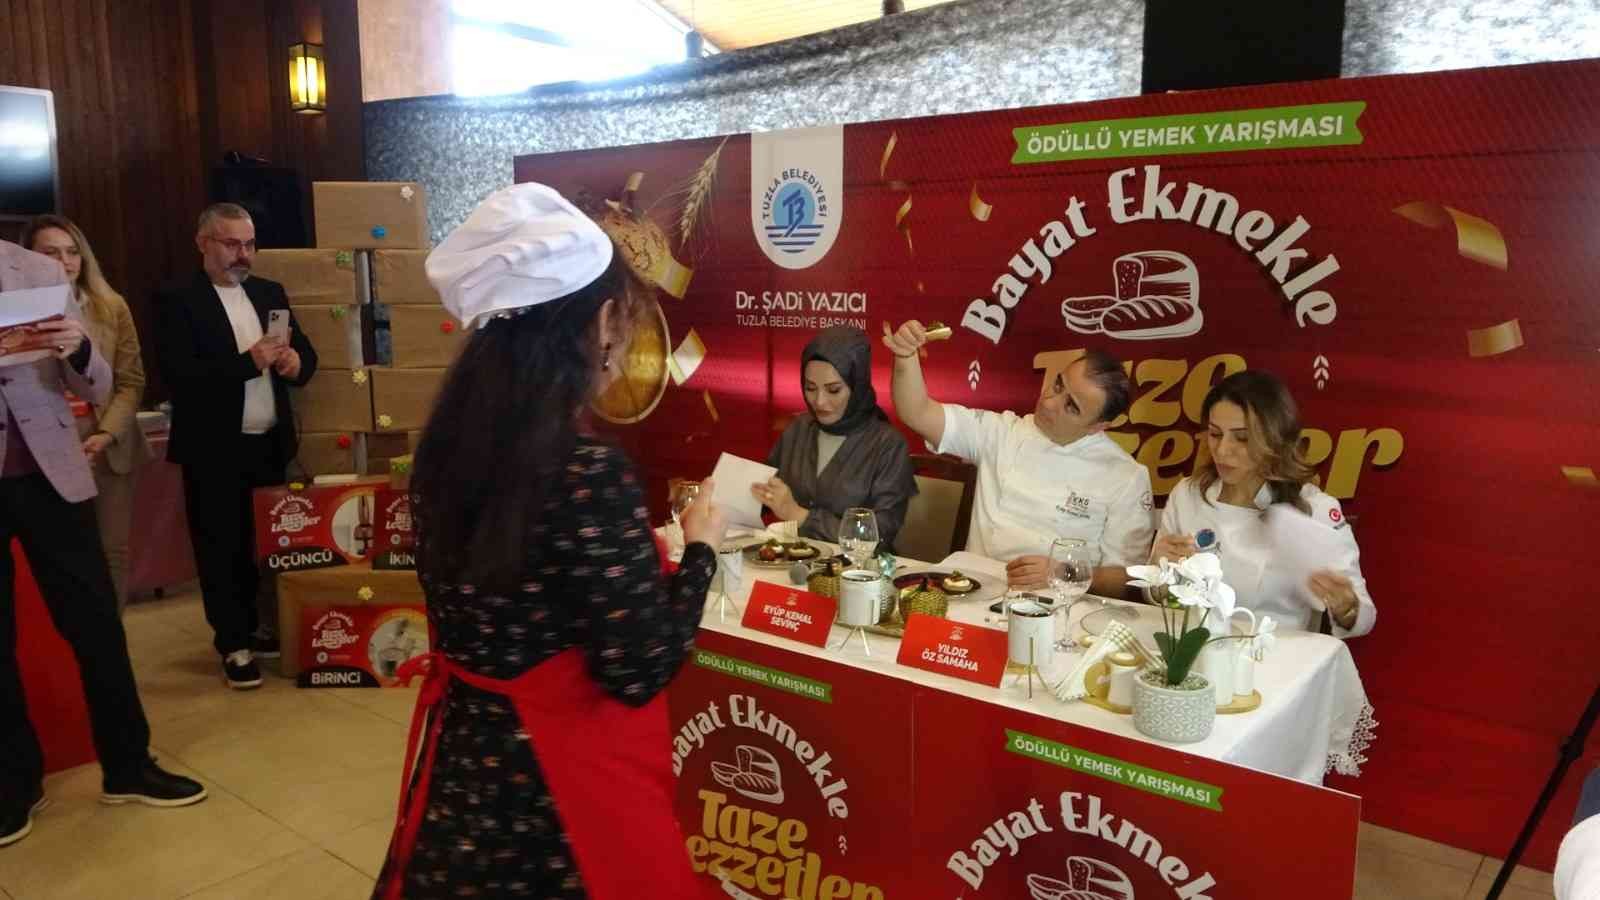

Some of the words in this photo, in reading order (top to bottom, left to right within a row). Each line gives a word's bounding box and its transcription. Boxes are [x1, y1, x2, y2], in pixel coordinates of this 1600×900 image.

[1026, 126, 1111, 155] ÖDÜLLÜ
[1118, 126, 1196, 147] YEMEK
[1203, 114, 1344, 143] YARIŞMASI
[762, 178, 781, 220] TUZLA
[960, 195, 1097, 345] Bayat
[1107, 164, 1341, 329] Ekmekle
[735, 290, 759, 310] Dr.
[807, 292, 867, 313] YAZICI
[736, 314, 768, 327] TUZLA
[268, 550, 333, 570] ÜÇÜNCÜ
[389, 552, 416, 566] İKİN
[936, 653, 979, 673] SAMAHA
[937, 643, 969, 659] YILDIZ
[735, 663, 769, 681] YEMEK
[728, 694, 849, 819] Ekmekle
[1014, 734, 1071, 763] ÖDÜLLÜ
[1073, 753, 1124, 780] YEMEK
[1126, 768, 1212, 803] YARIŞMASI
[698, 789, 808, 859] Taze
[946, 797, 1054, 891] Bayat
[1059, 791, 1217, 900] Ekmek
